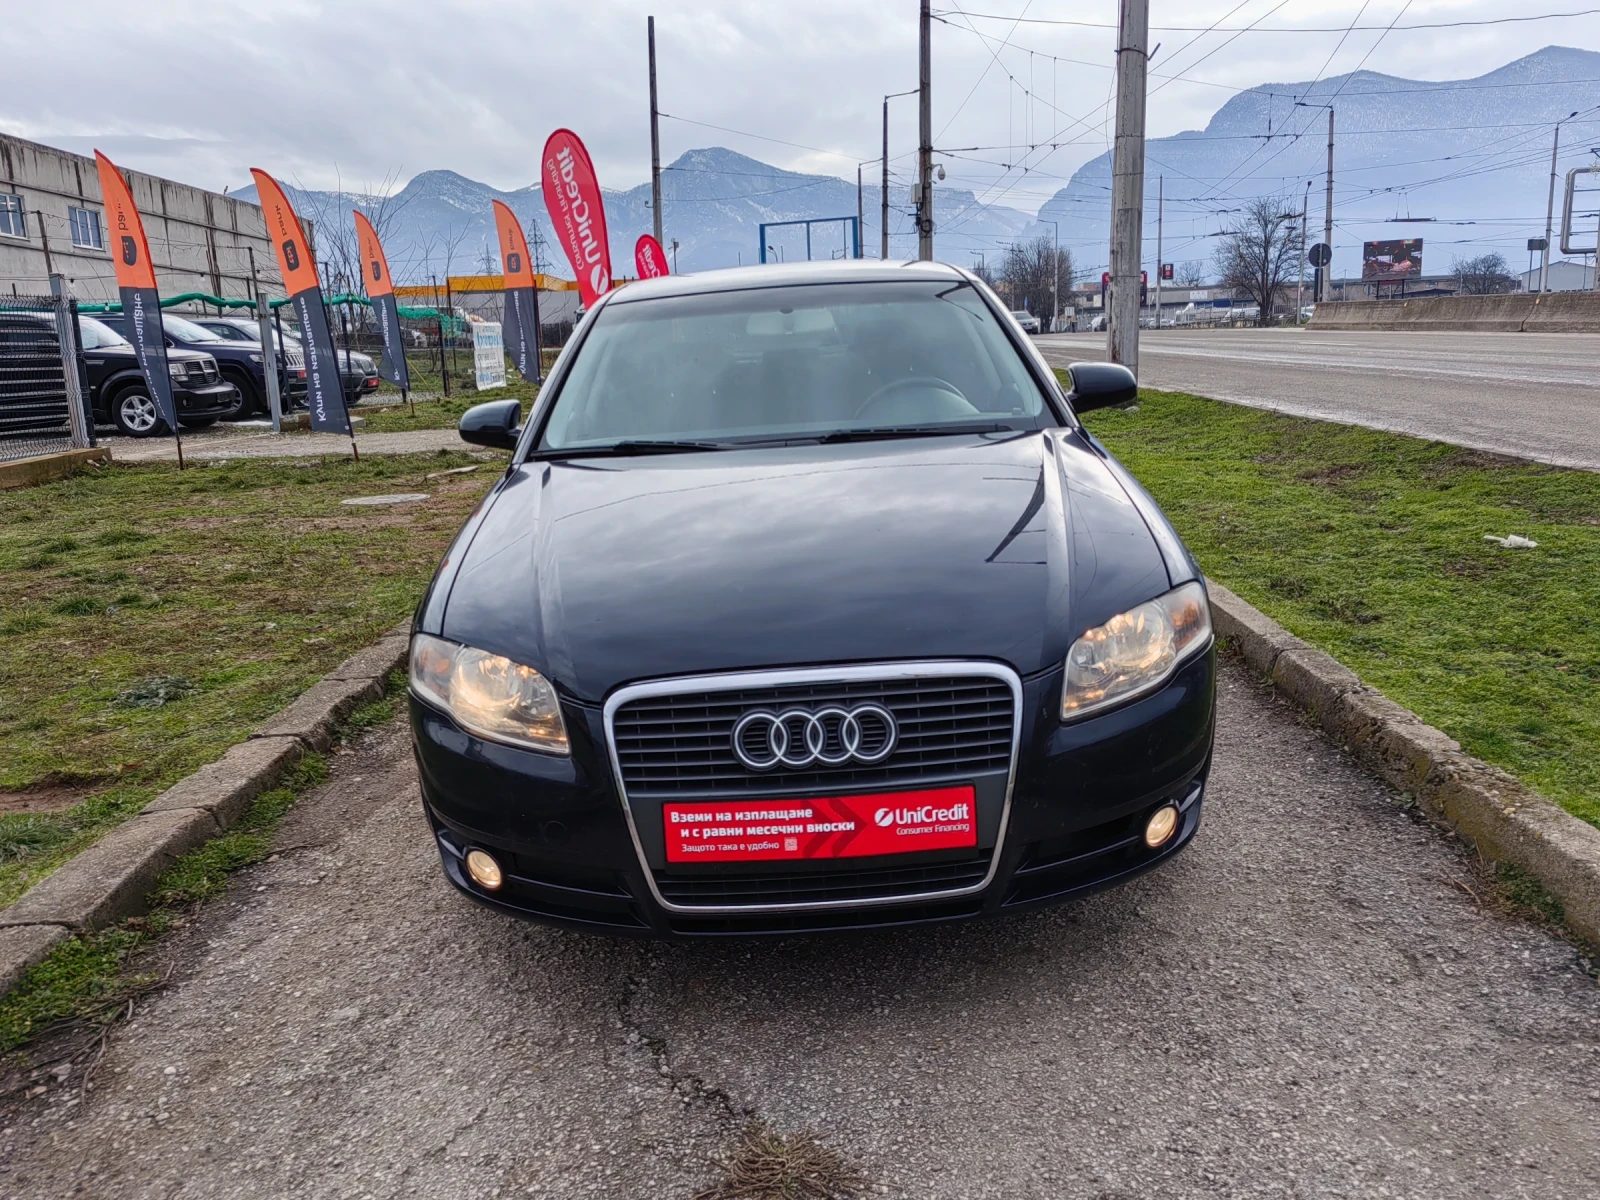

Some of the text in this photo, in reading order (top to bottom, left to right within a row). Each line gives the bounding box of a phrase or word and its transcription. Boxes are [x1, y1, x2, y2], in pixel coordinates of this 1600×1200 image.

[671, 808, 812, 823] Вземи на изплащане
[895, 804, 969, 826] UniCredit
[680, 820, 855, 839] и с равни месечни вноски
[896, 823, 970, 836] Consumer Financing
[681, 840, 780, 853] Защото така е удобно
